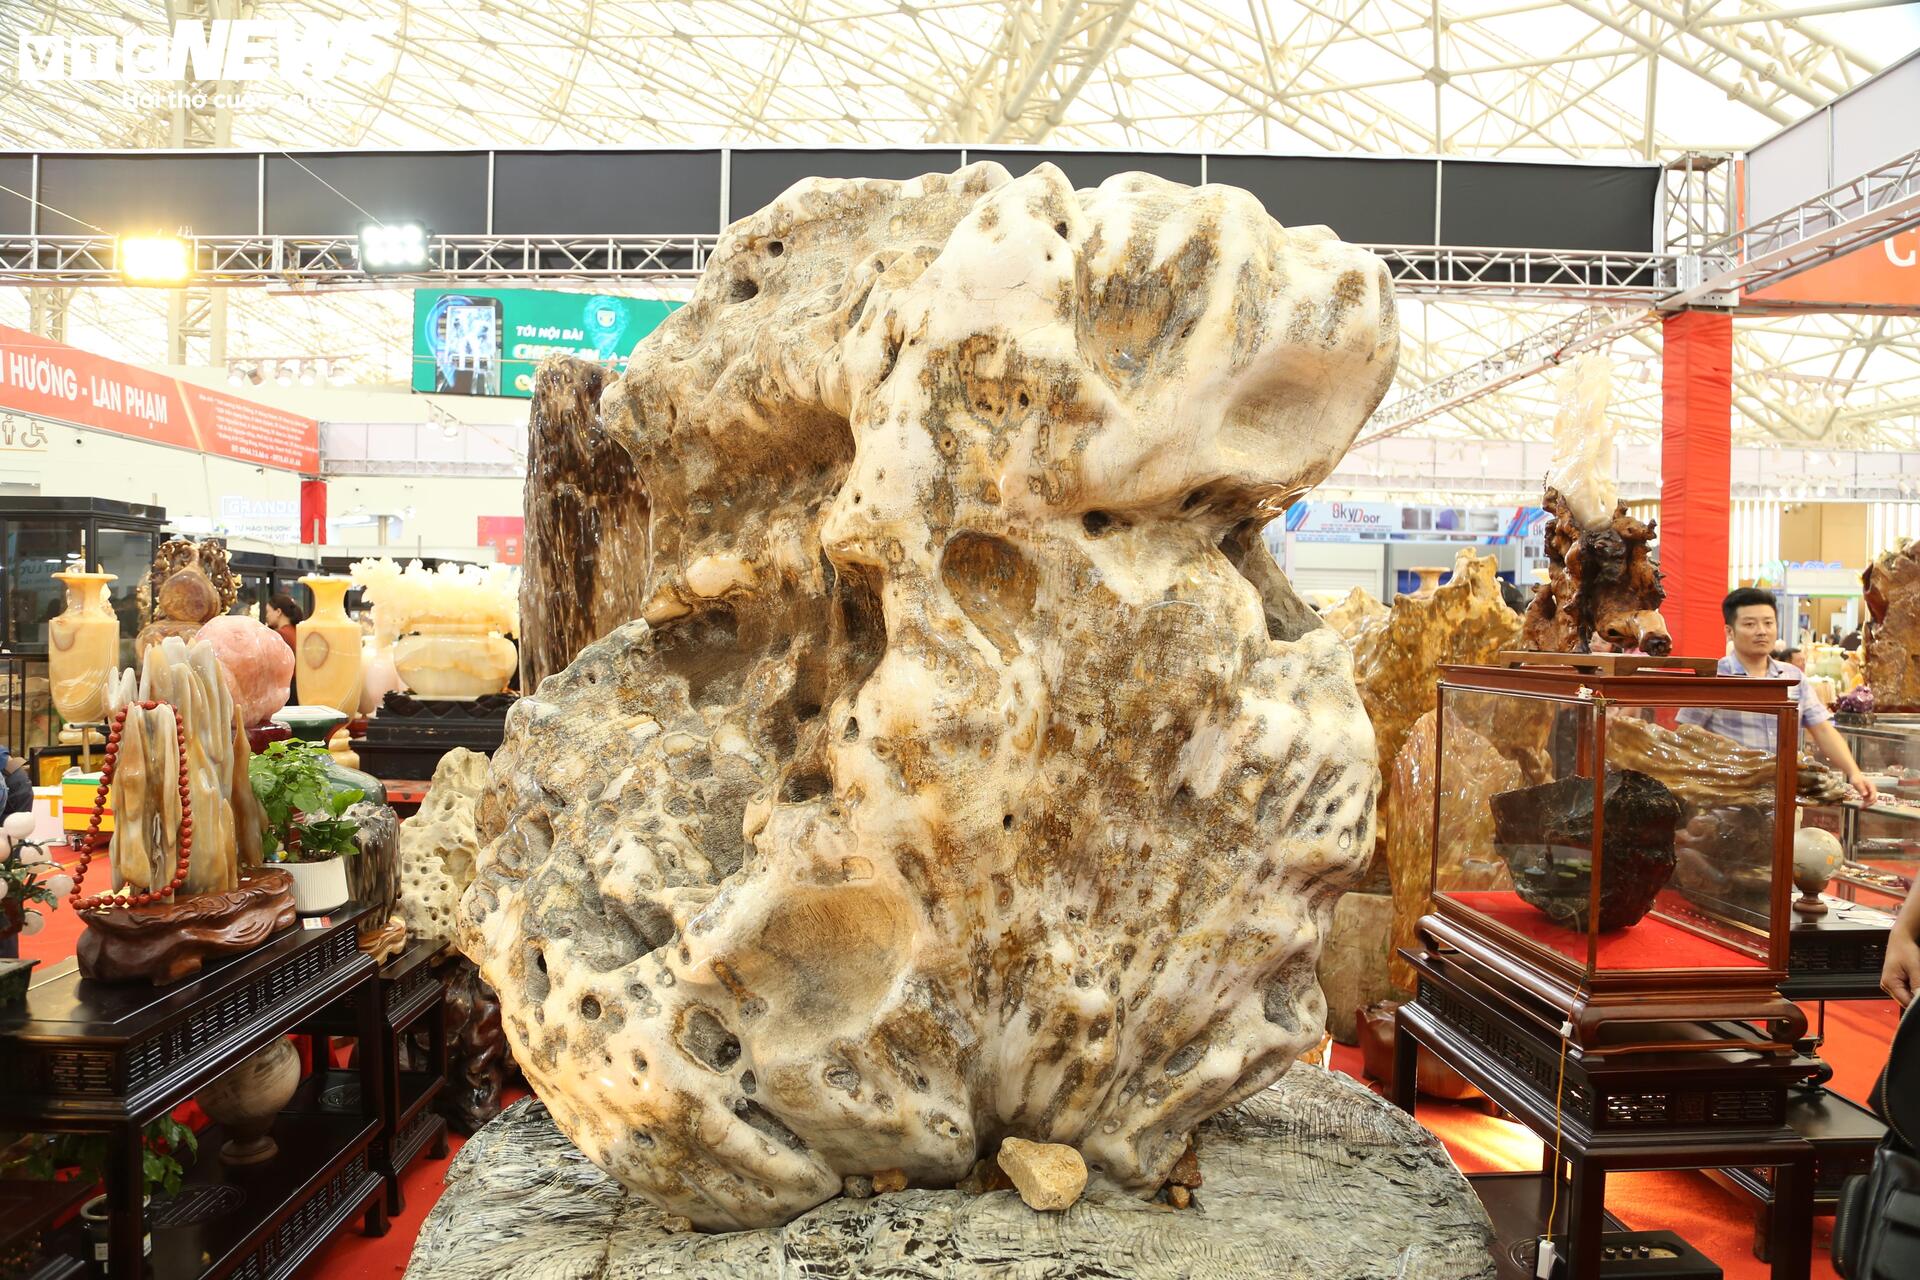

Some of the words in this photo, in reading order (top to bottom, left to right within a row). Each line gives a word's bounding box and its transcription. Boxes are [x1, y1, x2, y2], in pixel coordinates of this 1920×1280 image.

[562, 328, 584, 340] BÀI
[10, 352, 77, 400] HƯƠNG
[91, 375, 121, 412] LAN
[125, 385, 168, 429] PHẠM
